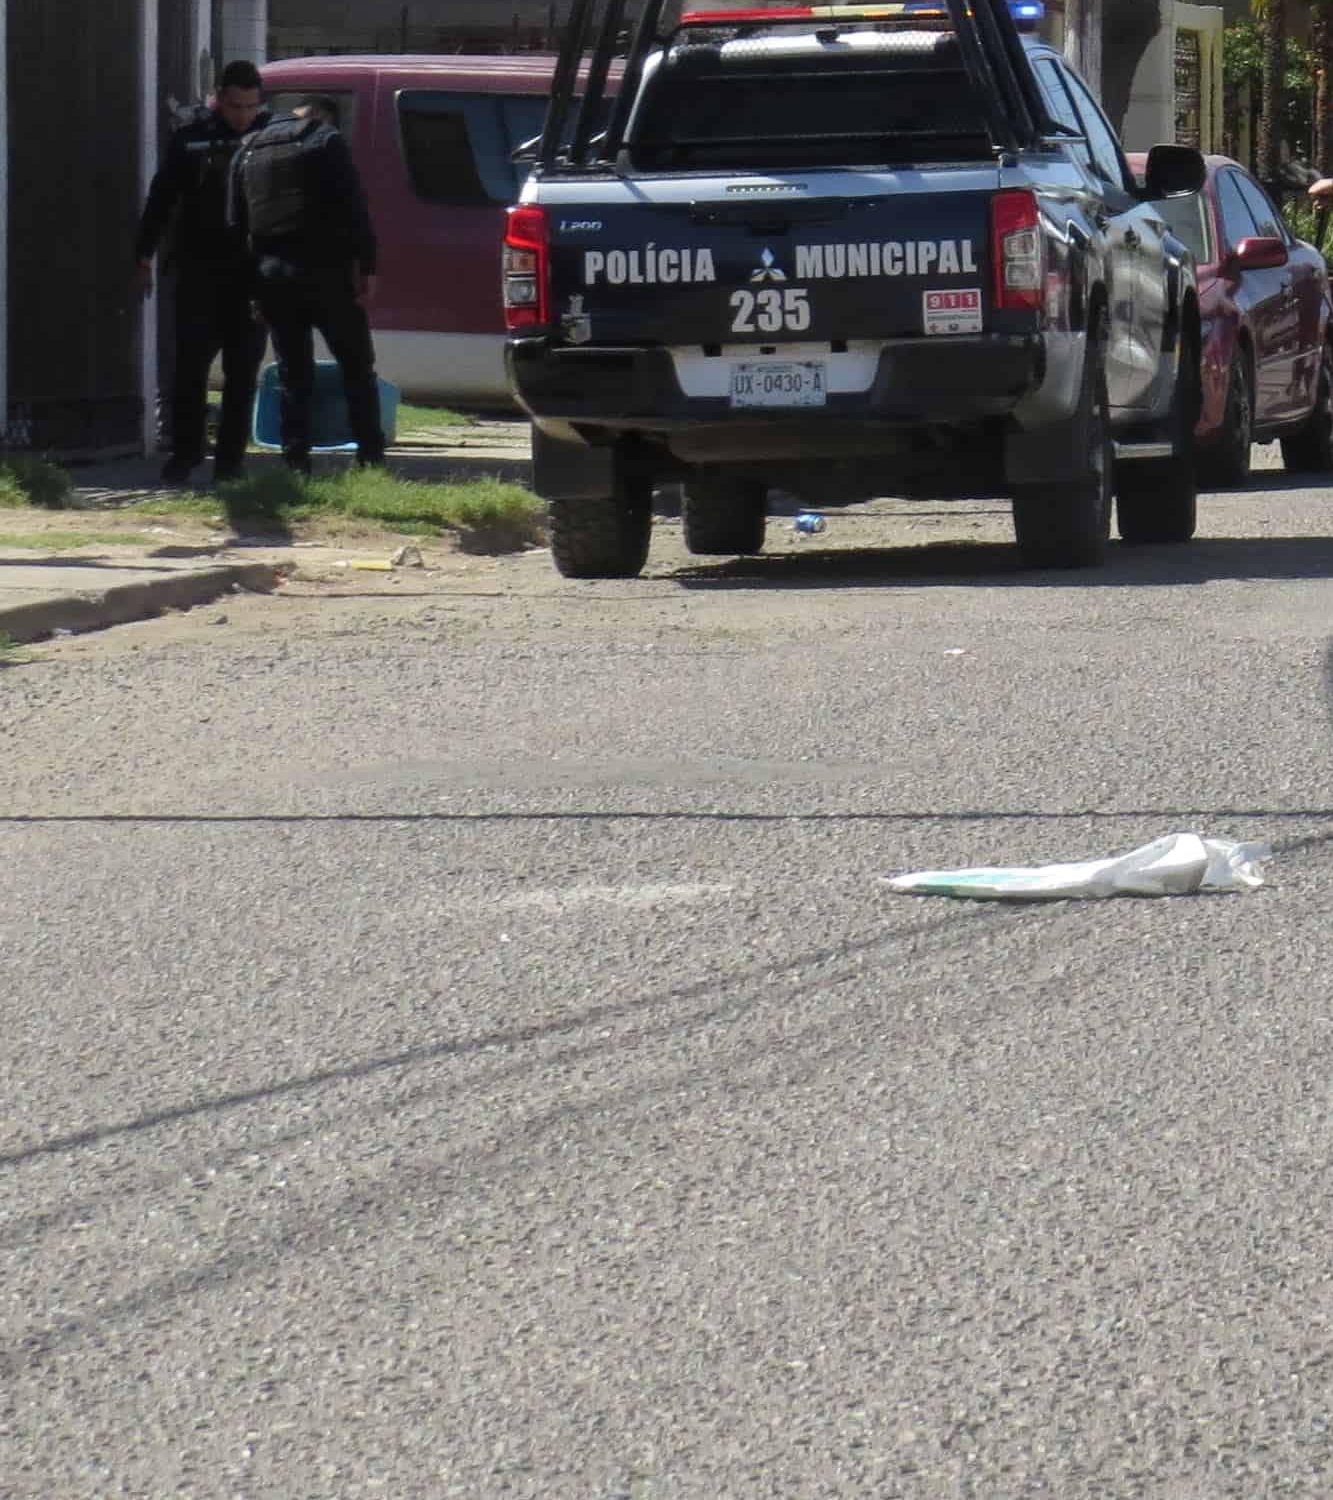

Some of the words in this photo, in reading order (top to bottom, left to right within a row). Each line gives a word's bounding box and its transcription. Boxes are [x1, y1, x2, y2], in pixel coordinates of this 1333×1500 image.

[584, 242, 716, 285] POLÍCIA
[795, 240, 977, 279] MUNICIPAL
[729, 289, 811, 333] 235
[929, 293, 975, 309] 911
